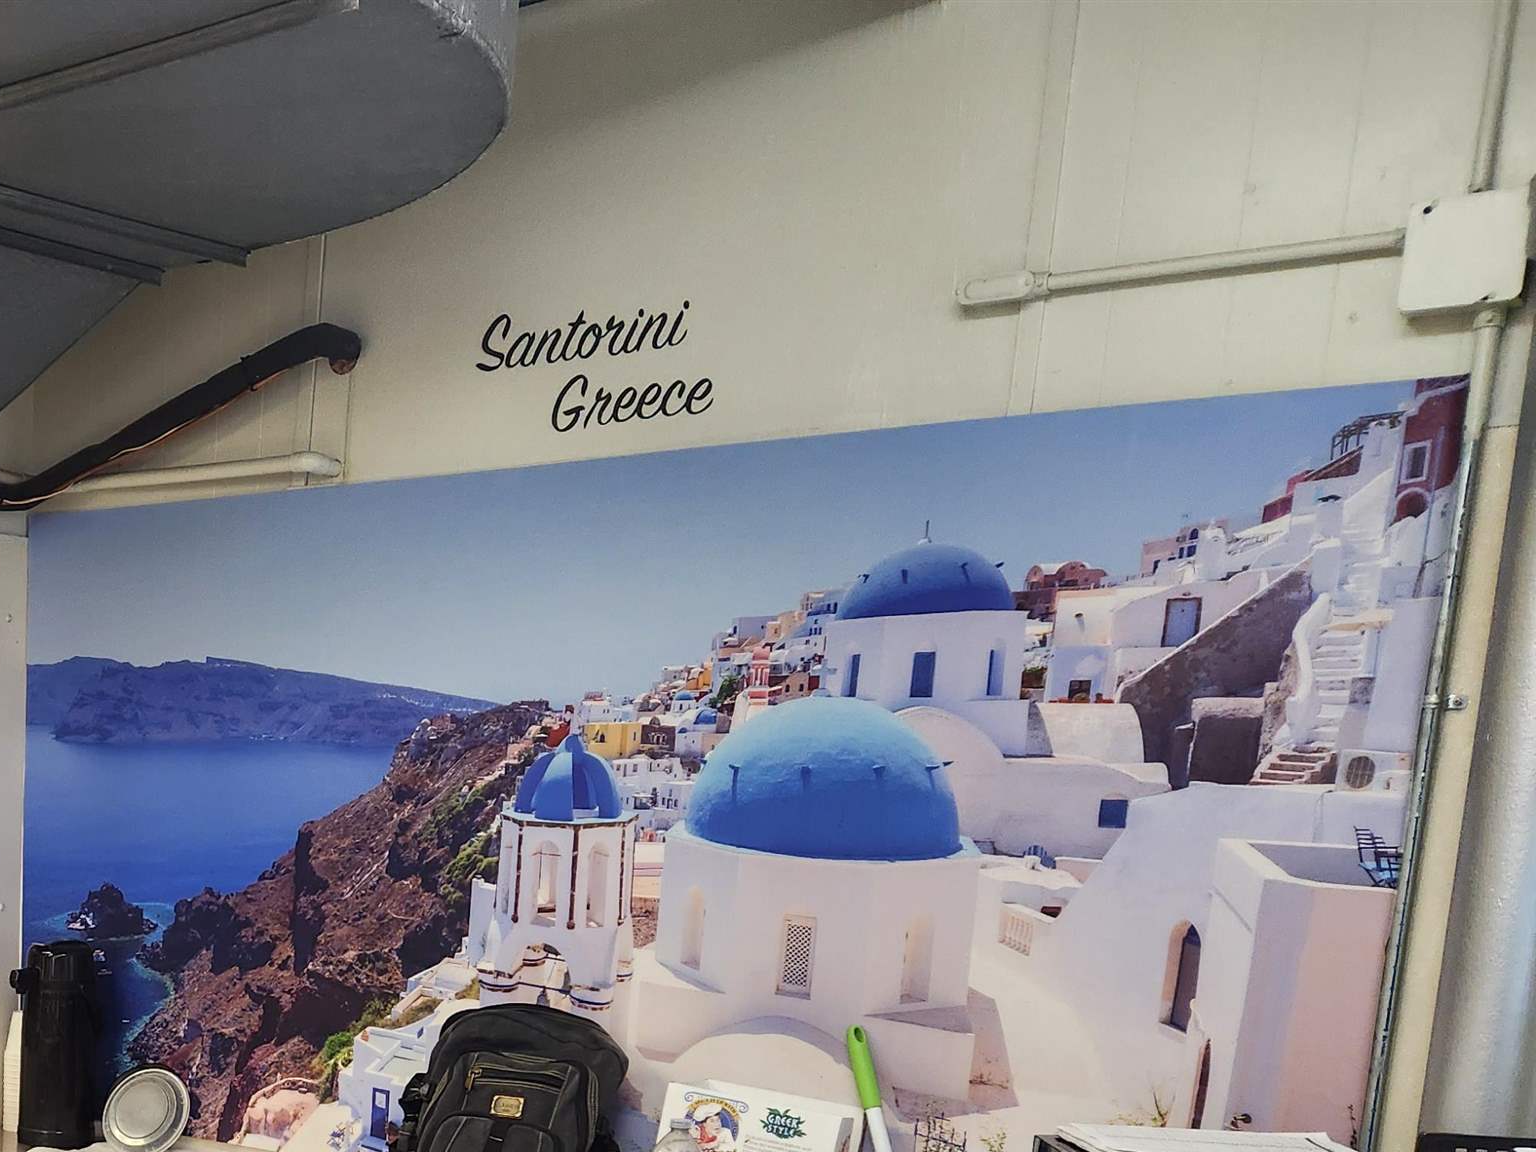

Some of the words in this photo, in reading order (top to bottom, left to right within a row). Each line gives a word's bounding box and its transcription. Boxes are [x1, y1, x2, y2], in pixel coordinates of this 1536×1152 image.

[475, 300, 690, 372] Santorini
[551, 374, 714, 433] Greece
[765, 1124, 796, 1138] STYLE
[766, 1113, 801, 1128] GREEK
